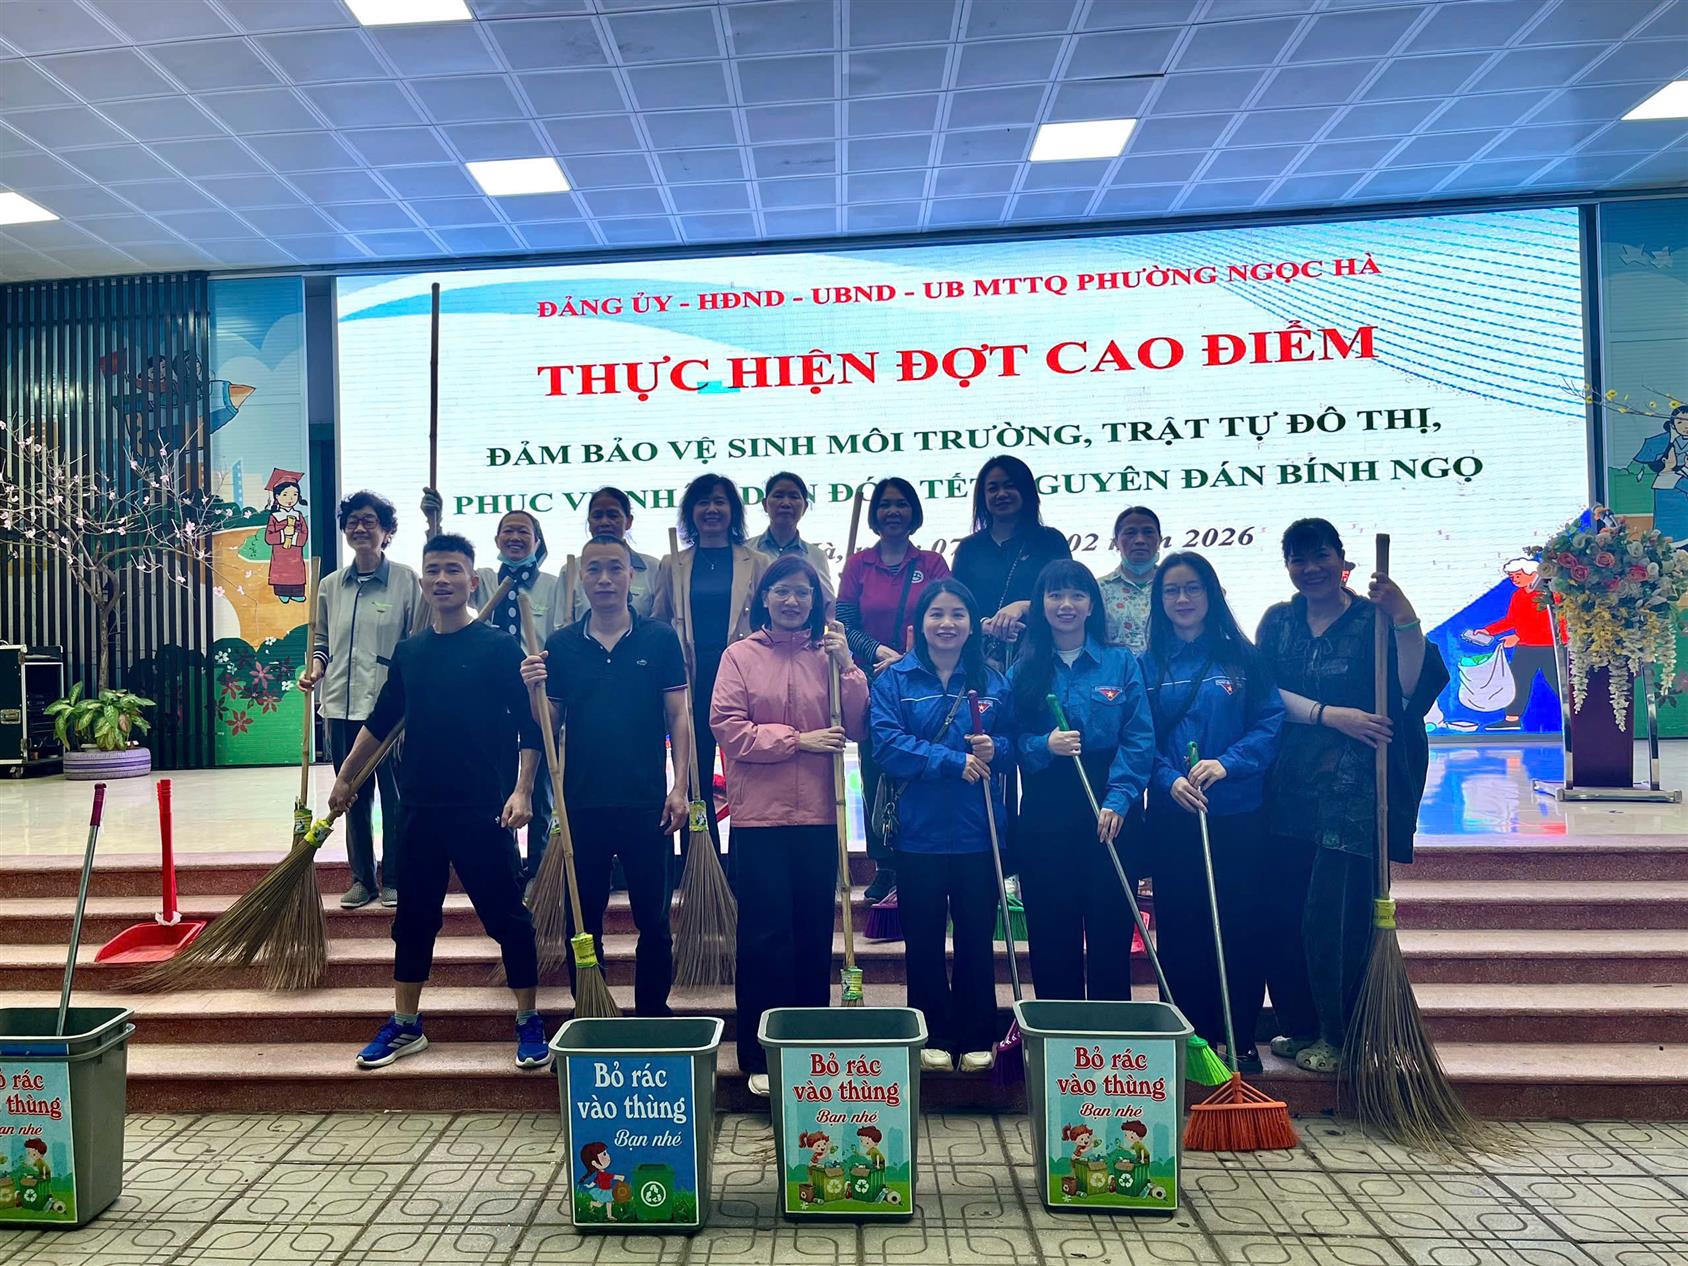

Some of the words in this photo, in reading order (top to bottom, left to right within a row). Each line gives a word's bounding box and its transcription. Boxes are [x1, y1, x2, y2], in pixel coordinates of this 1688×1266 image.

[537, 296, 623, 318] ĐẢNG
[632, 292, 672, 313] ỦY
[697, 290, 785, 311] HĐND
[811, 284, 896, 305] UBND
[923, 281, 965, 299] UB
[973, 275, 1068, 297] MTTQ
[1077, 265, 1217, 291] PHƯỜNG
[1228, 260, 1323, 283] NGỌC
[1334, 252, 1382, 276] HÀ
[537, 355, 710, 401] THỰC
[726, 348, 880, 395] HIỆN
[896, 343, 1028, 388] ĐỢT
[1046, 336, 1184, 375] CAO
[1201, 320, 1379, 366] ĐIỂM
[486, 440, 571, 467] ĐẢM
[581, 437, 658, 463] BẢO
[667, 436, 717, 465] VỆ
[728, 435, 817, 459] SINH
[826, 427, 904, 455] MÔI
[914, 422, 1092, 451] TRƯỜNG,
[1102, 416, 1210, 446] TRẬT
[1219, 410, 1278, 442] TỰ
[1286, 406, 1346, 434] ĐÔ
[1357, 407, 1442, 434] THỊ,
[562, 492, 596, 511] V
[828, 476, 876, 503] ĐÓ
[920, 472, 976, 499] TẾ
[1035, 465, 1170, 495] GUYÊN
[1181, 460, 1266, 489] ĐÁN
[1276, 456, 1380, 485] BÍNH
[1390, 456, 1484, 482] NGỌ
[1068, 533, 1099, 553] 02
[1182, 526, 1255, 548] 2026
[810, 1052, 840, 1076] Bỏ
[846, 1054, 882, 1076] rác
[1074, 1046, 1105, 1069] Bỏ
[1111, 1049, 1148, 1070] rác
[12, 1069, 45, 1090] rác
[594, 1061, 624, 1088] Bỏ
[632, 1063, 667, 1087] rác
[1057, 1073, 1097, 1096] vào
[1103, 1073, 1166, 1101] thùng
[6, 1093, 62, 1120] thùng
[792, 1080, 832, 1102] vào
[838, 1080, 900, 1106] thùng
[577, 1095, 617, 1119] vào
[624, 1094, 687, 1124] thùng
[816, 1109, 847, 1126] Bạn
[850, 1110, 878, 1123] nhé
[1080, 1102, 1111, 1119] Bạn
[1115, 1104, 1143, 1117] nhé
[18, 1123, 43, 1135] nhé
[614, 1129, 648, 1151] Bạn
[652, 1130, 682, 1147] nhé
